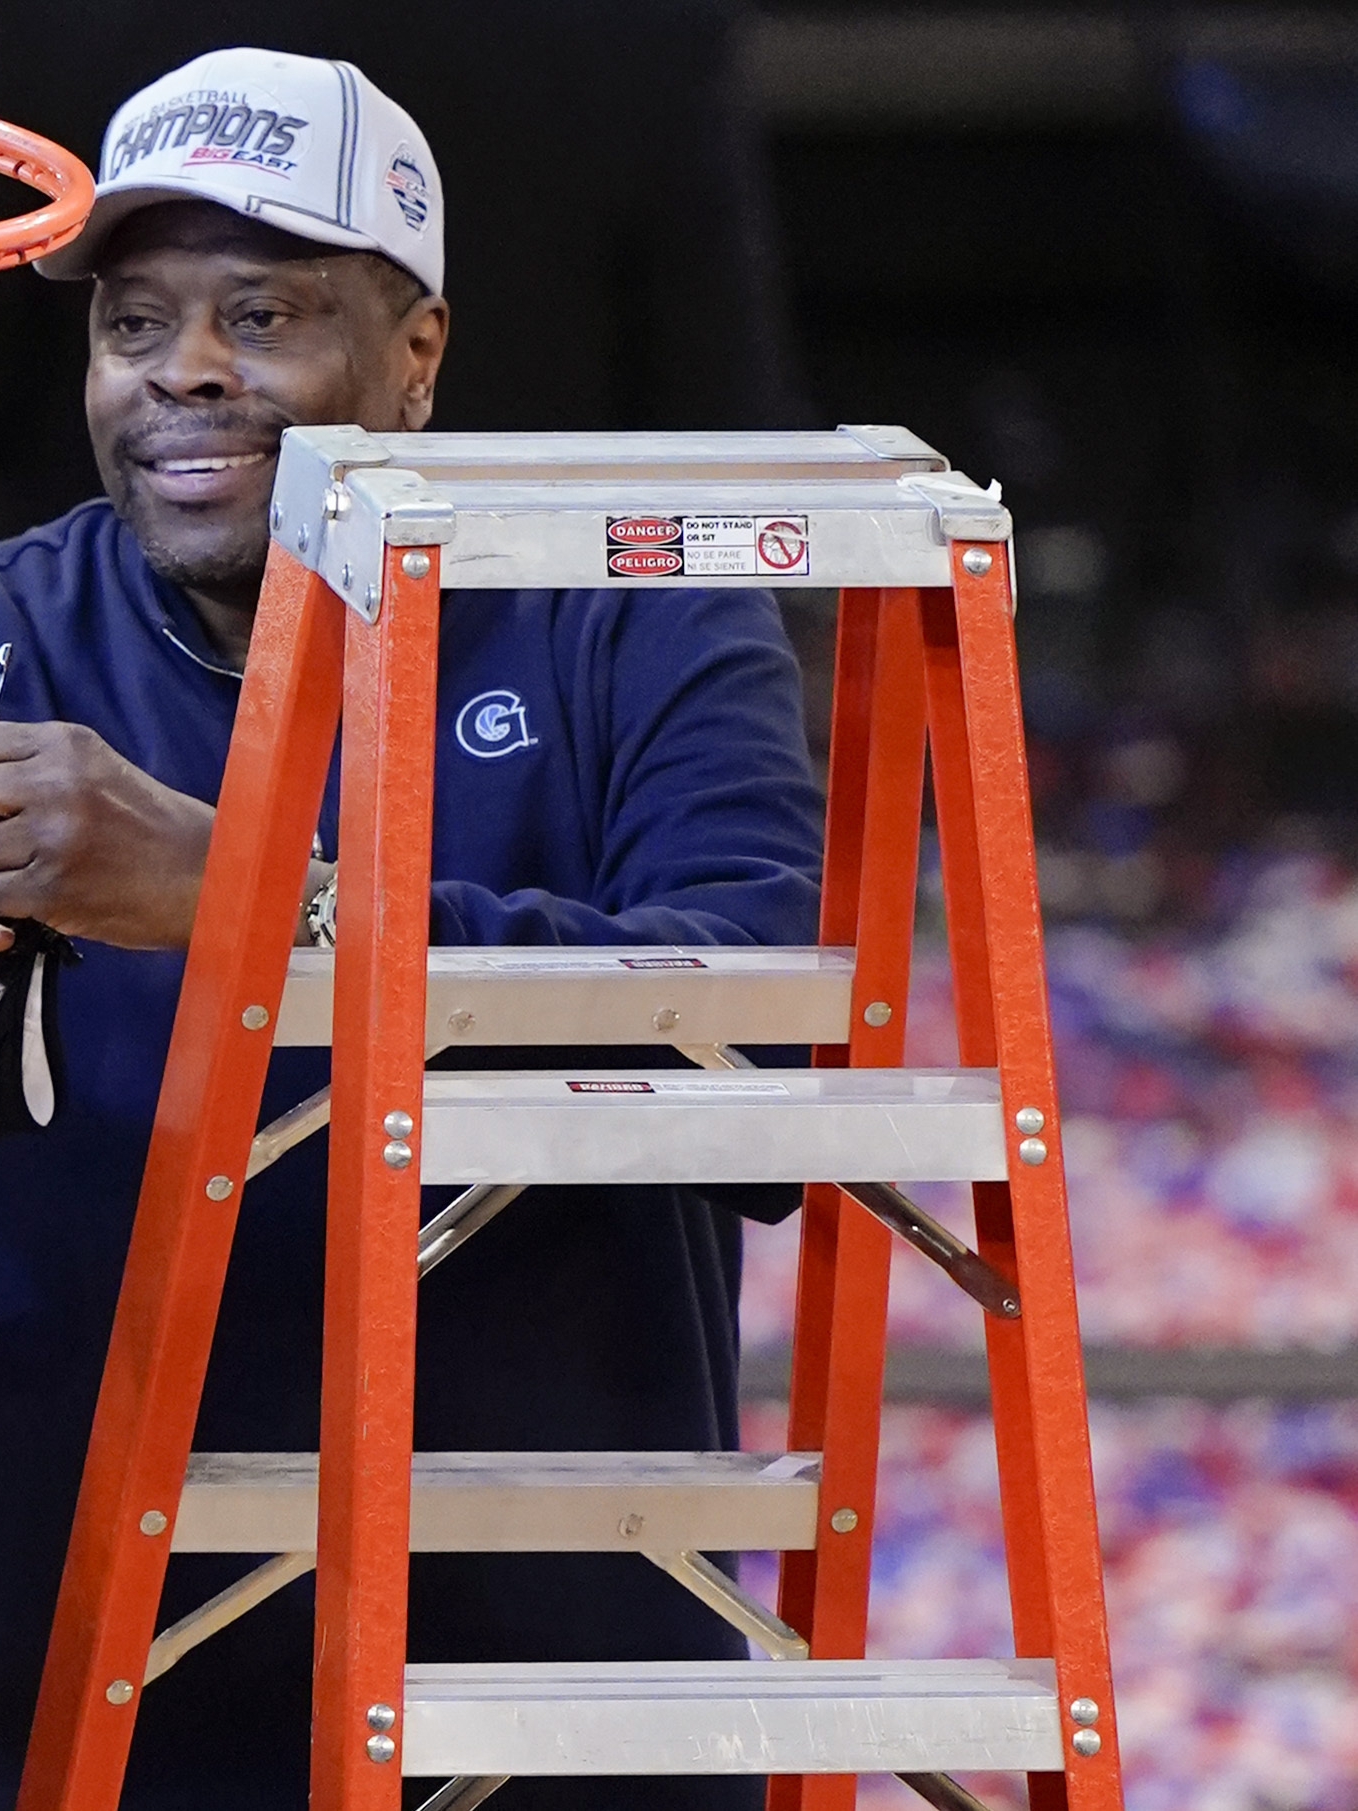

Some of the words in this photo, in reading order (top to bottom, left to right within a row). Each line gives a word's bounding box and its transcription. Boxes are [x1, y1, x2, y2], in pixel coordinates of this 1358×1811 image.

[152, 90, 249, 117] BASKETBALL
[109, 103, 309, 181] CHAMPIONS
[190, 147, 233, 160] BIG
[231, 150, 298, 172] EAST
[616, 525, 676, 537] DANGER
[686, 521, 699, 530] DO
[701, 521, 720, 530] NOT
[722, 521, 753, 530] STAND
[686, 533, 700, 542] OR
[702, 533, 716, 542] SIT
[687, 550, 701, 560] NO
[703, 550, 715, 560] SE
[718, 550, 741, 560] PARE
[616, 557, 676, 568] PELIGRO
[687, 563, 697, 572] NI
[700, 562, 711, 572] SE
[714, 562, 746, 572] SIENTE
